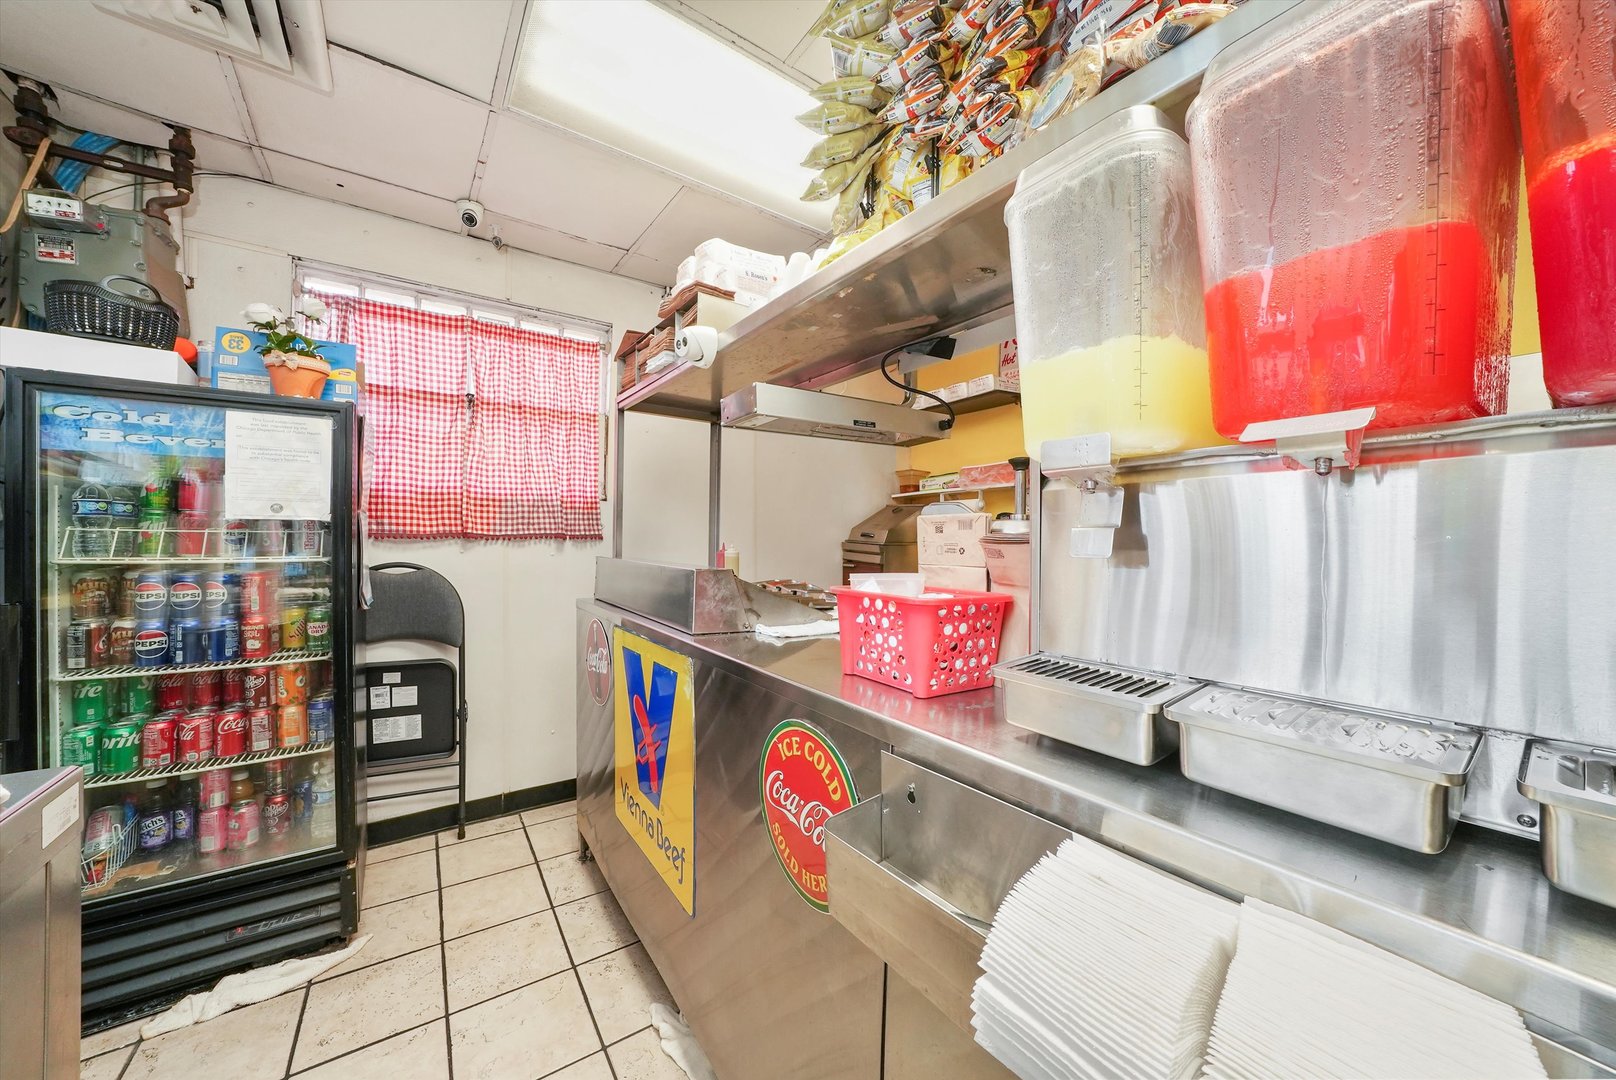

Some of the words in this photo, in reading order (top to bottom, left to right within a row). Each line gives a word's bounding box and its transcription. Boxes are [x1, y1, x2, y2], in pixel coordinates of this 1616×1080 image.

[1001, 352, 1016, 367] Hot
[52, 404, 173, 426] Cold
[80, 426, 225, 449] Bever
[111, 630, 133, 640] MU
[135, 640, 167, 648] PEPSI
[74, 684, 103, 699] ite
[102, 731, 142, 749] prite
[777, 737, 802, 761] ICE
[803, 740, 842, 801] COLD
[766, 770, 834, 853] Coca-Co
[141, 816, 165, 833] elch's
[620, 775, 655, 840] Vienna
[656, 817, 686, 885] Beef
[772, 821, 799, 874] SOLD
[801, 867, 828, 893] HER
